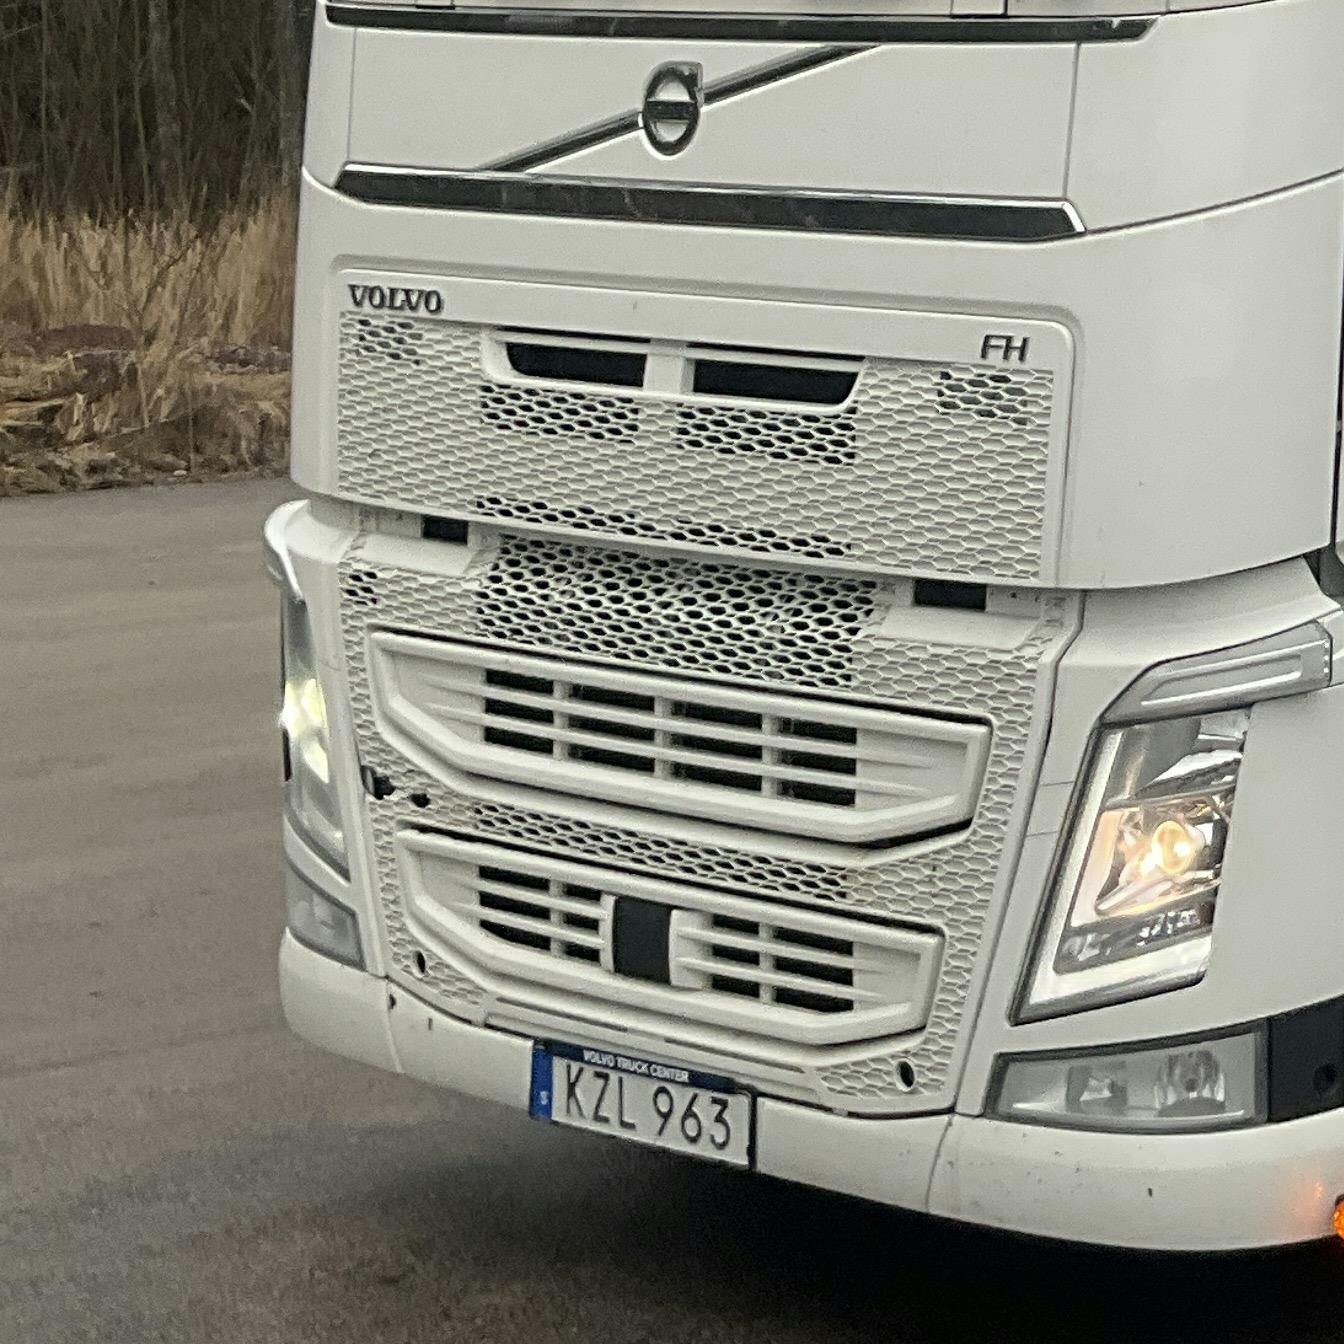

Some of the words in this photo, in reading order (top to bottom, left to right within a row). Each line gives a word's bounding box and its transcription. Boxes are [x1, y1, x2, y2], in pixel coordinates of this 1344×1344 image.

[349, 284, 444, 313] VOLVO
[980, 334, 1030, 362] FH
[583, 1049, 615, 1068] VOLVO
[616, 1056, 649, 1076] TRUCK
[565, 1063, 637, 1131] KZL
[652, 1085, 731, 1150] 963
